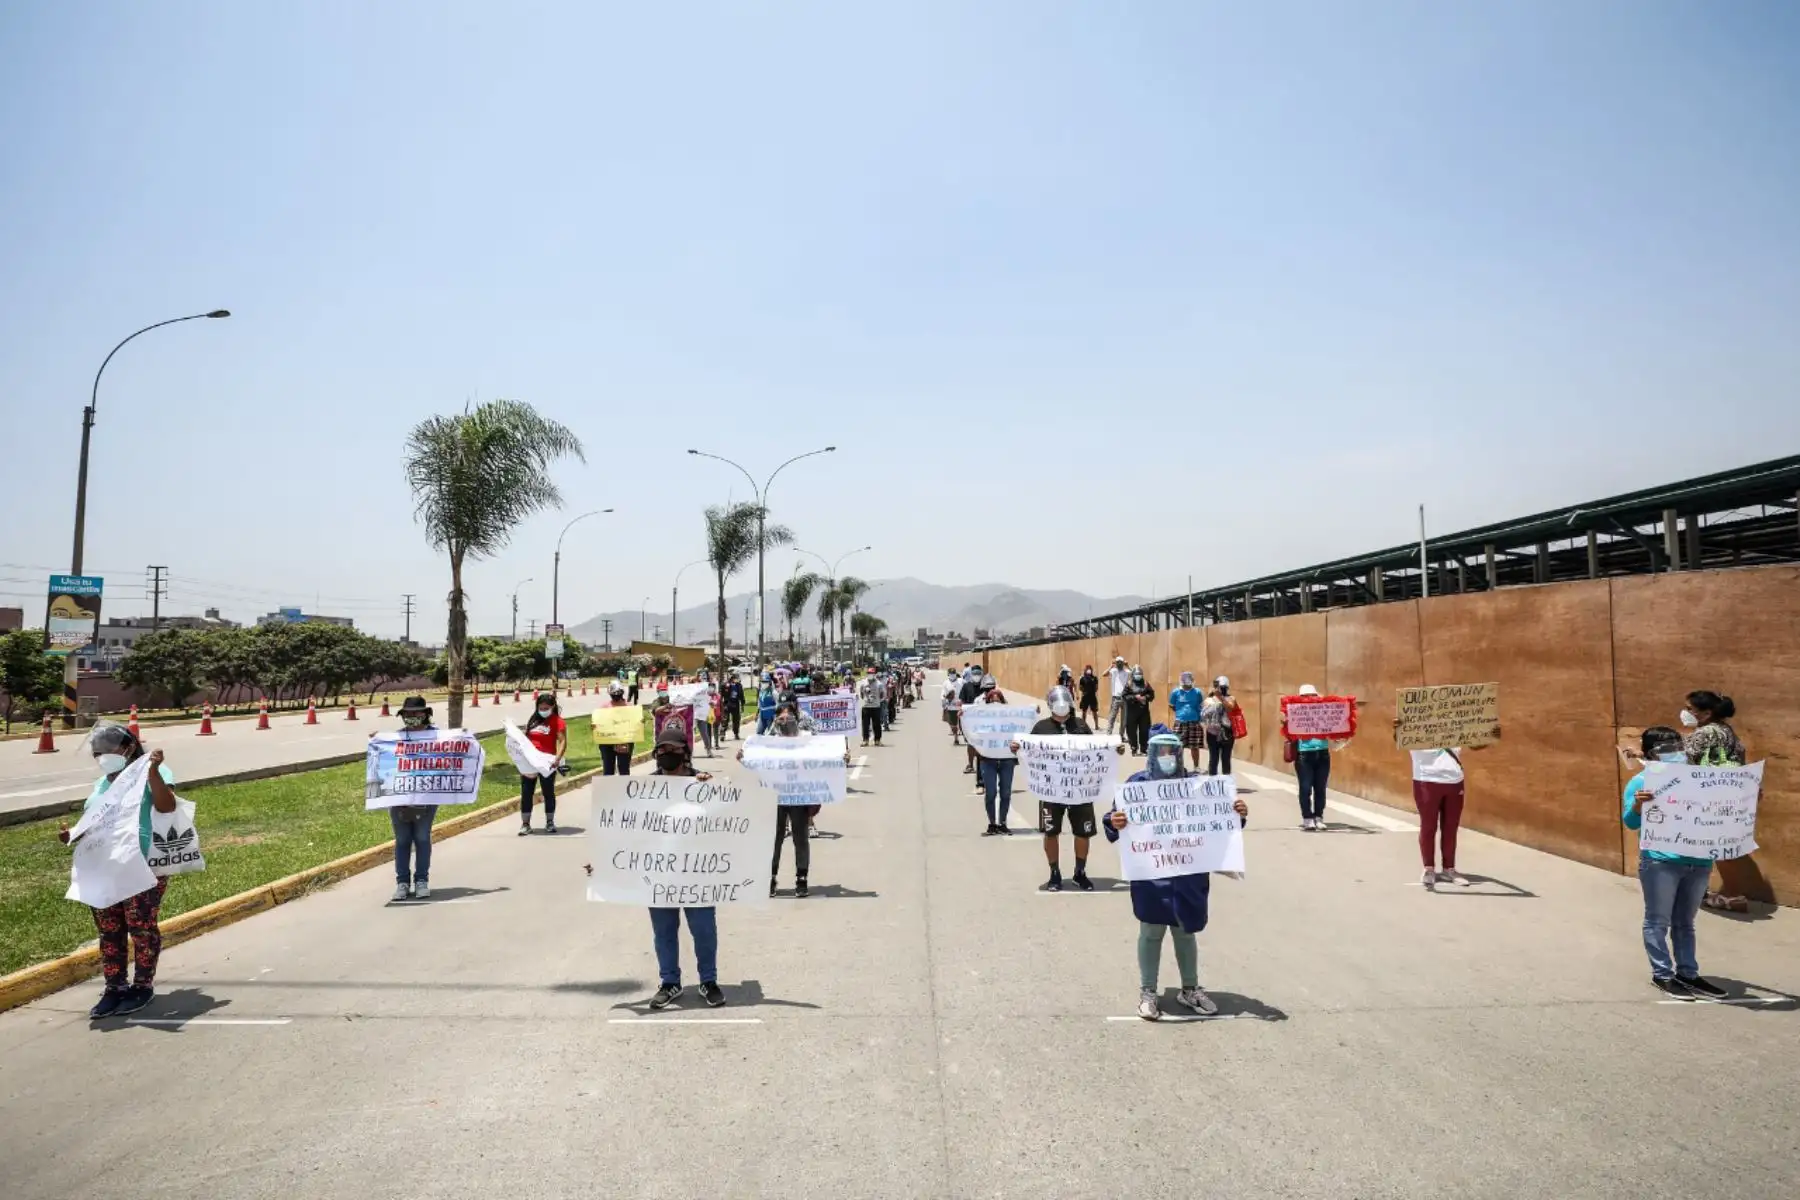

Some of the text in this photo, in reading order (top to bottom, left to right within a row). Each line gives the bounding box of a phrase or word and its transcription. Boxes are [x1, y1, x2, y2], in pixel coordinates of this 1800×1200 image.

[393, 775, 465, 793] PRESENTE
[626, 780, 670, 800] OLLA
[684, 781, 742, 803] COMÚN
[642, 811, 691, 835] NUEVO
[1042, 807, 1055, 832] FILA
[148, 850, 200, 868] adidas
[612, 850, 731, 873] CHORRILLOS
